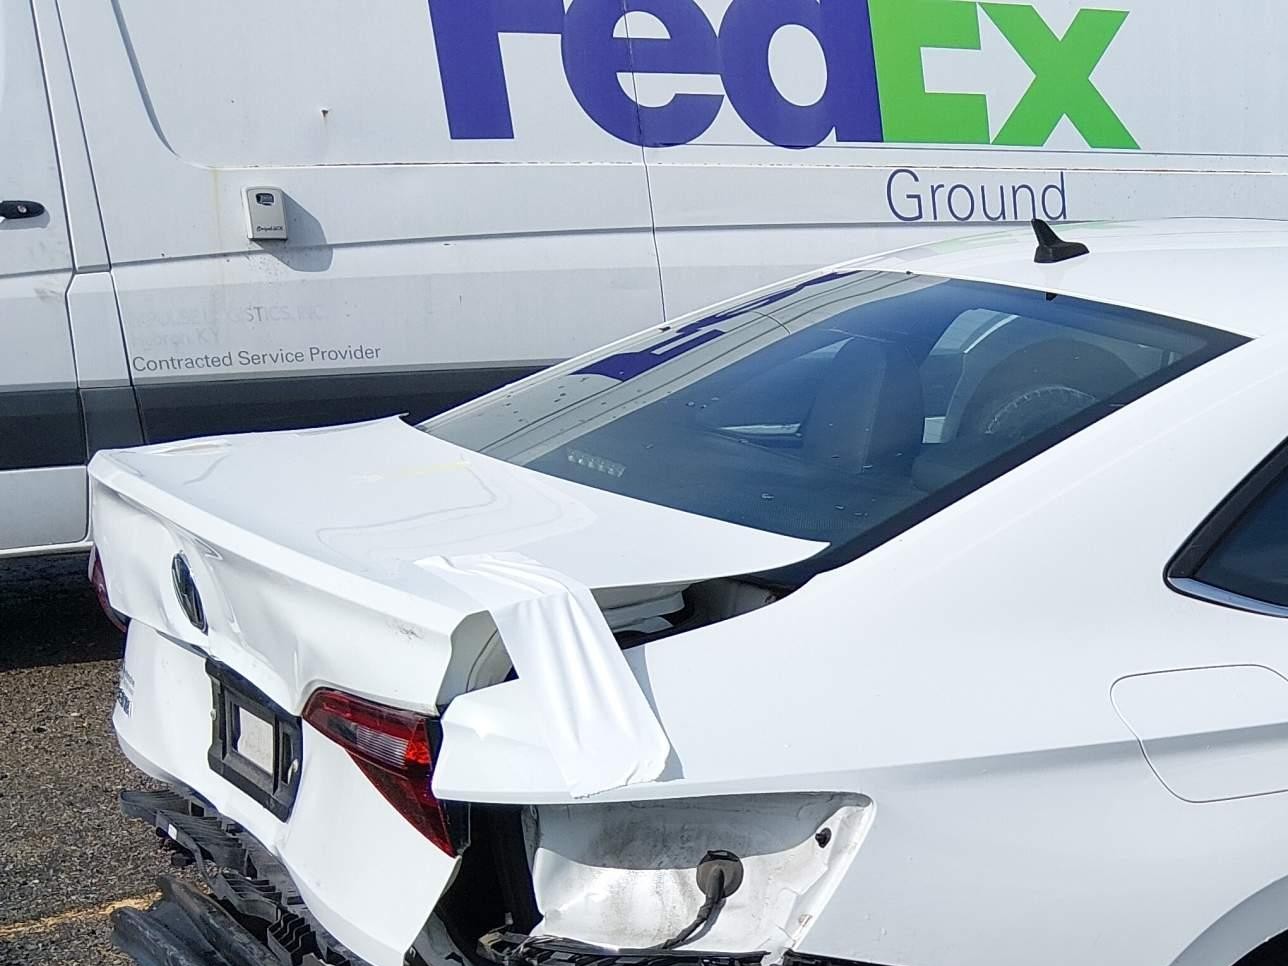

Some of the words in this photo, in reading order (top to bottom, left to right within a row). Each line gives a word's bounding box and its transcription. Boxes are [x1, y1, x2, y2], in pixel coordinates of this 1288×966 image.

[886, 168, 1068, 221] Ground
[133, 352, 232, 372] Contracted
[238, 349, 304, 366] Service
[309, 345, 381, 361] Provider
